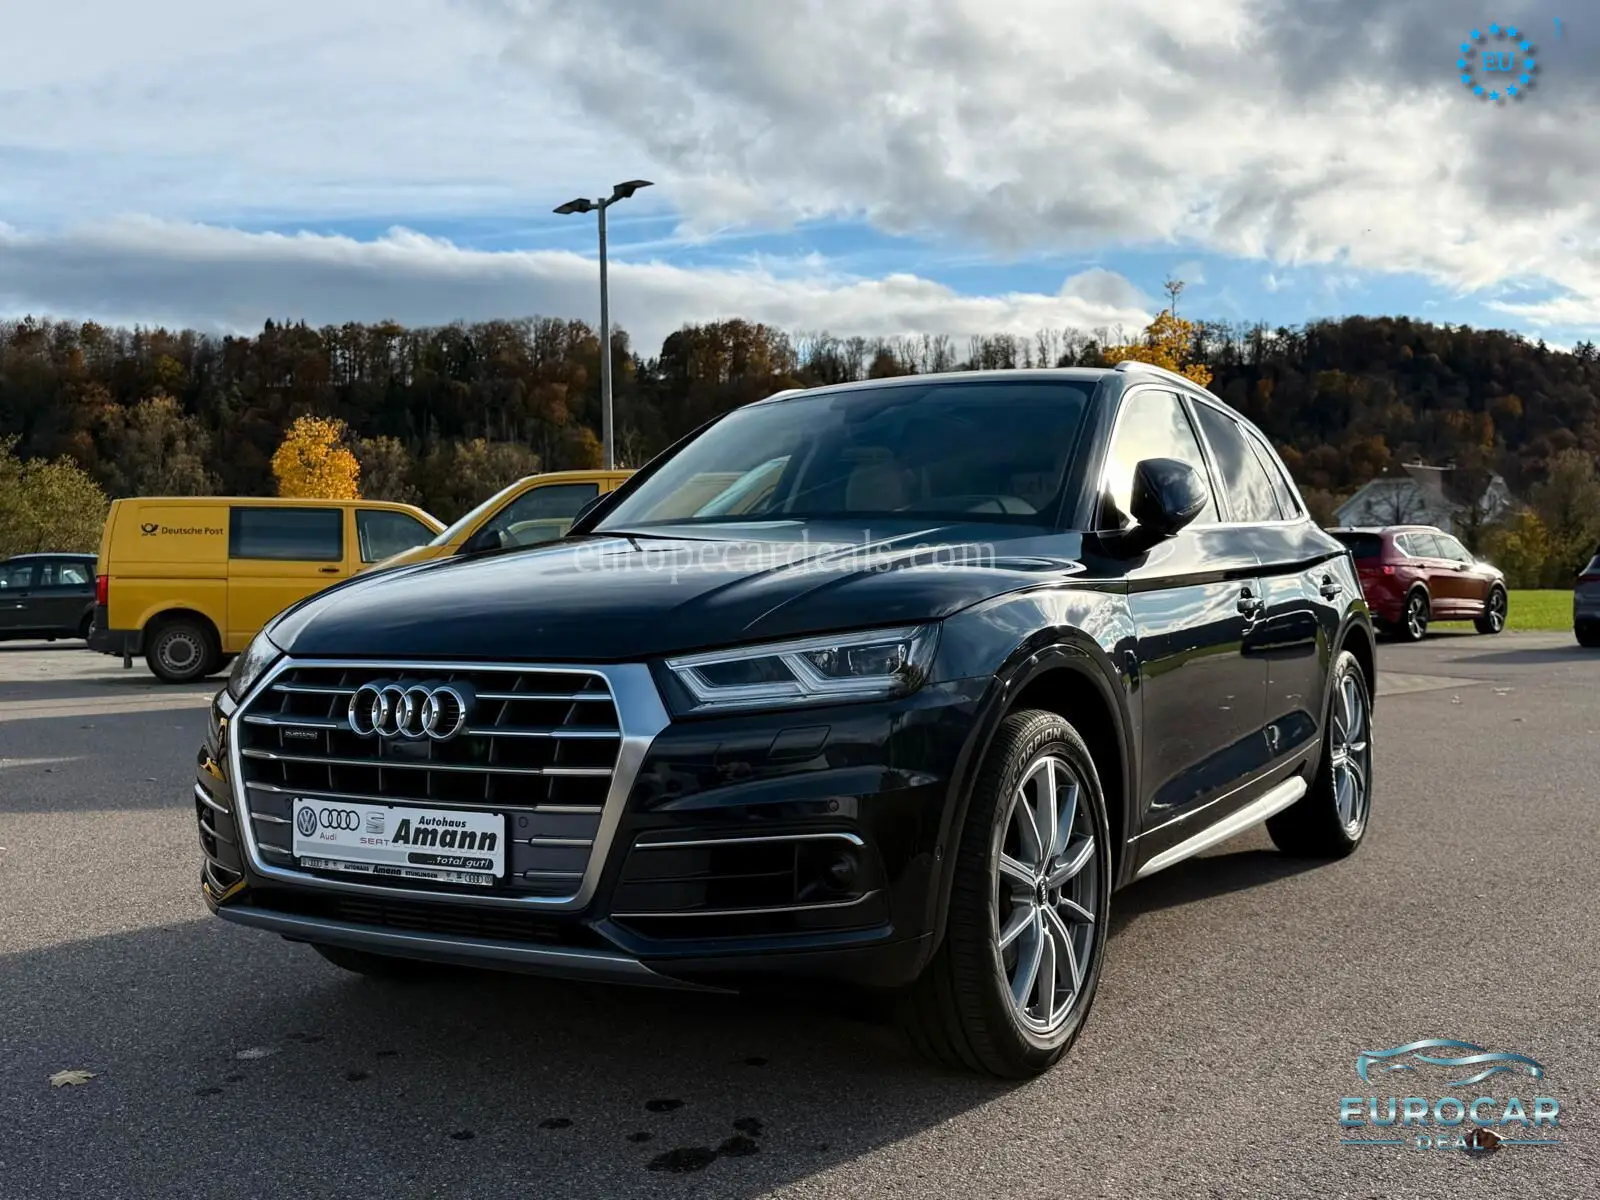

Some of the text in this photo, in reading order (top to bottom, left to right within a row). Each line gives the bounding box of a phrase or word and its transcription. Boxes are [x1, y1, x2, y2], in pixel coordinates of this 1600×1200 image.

[161, 526, 224, 535] Deutsche Post
[1006, 727, 1061, 802] SCORPION
[418, 815, 467, 828] Autohaus
[319, 831, 337, 841] Audi
[391, 818, 498, 851] Amann
[360, 837, 390, 847] SEAT
[343, 863, 370, 872] AUTOHAUS
[372, 865, 402, 876] Amann
